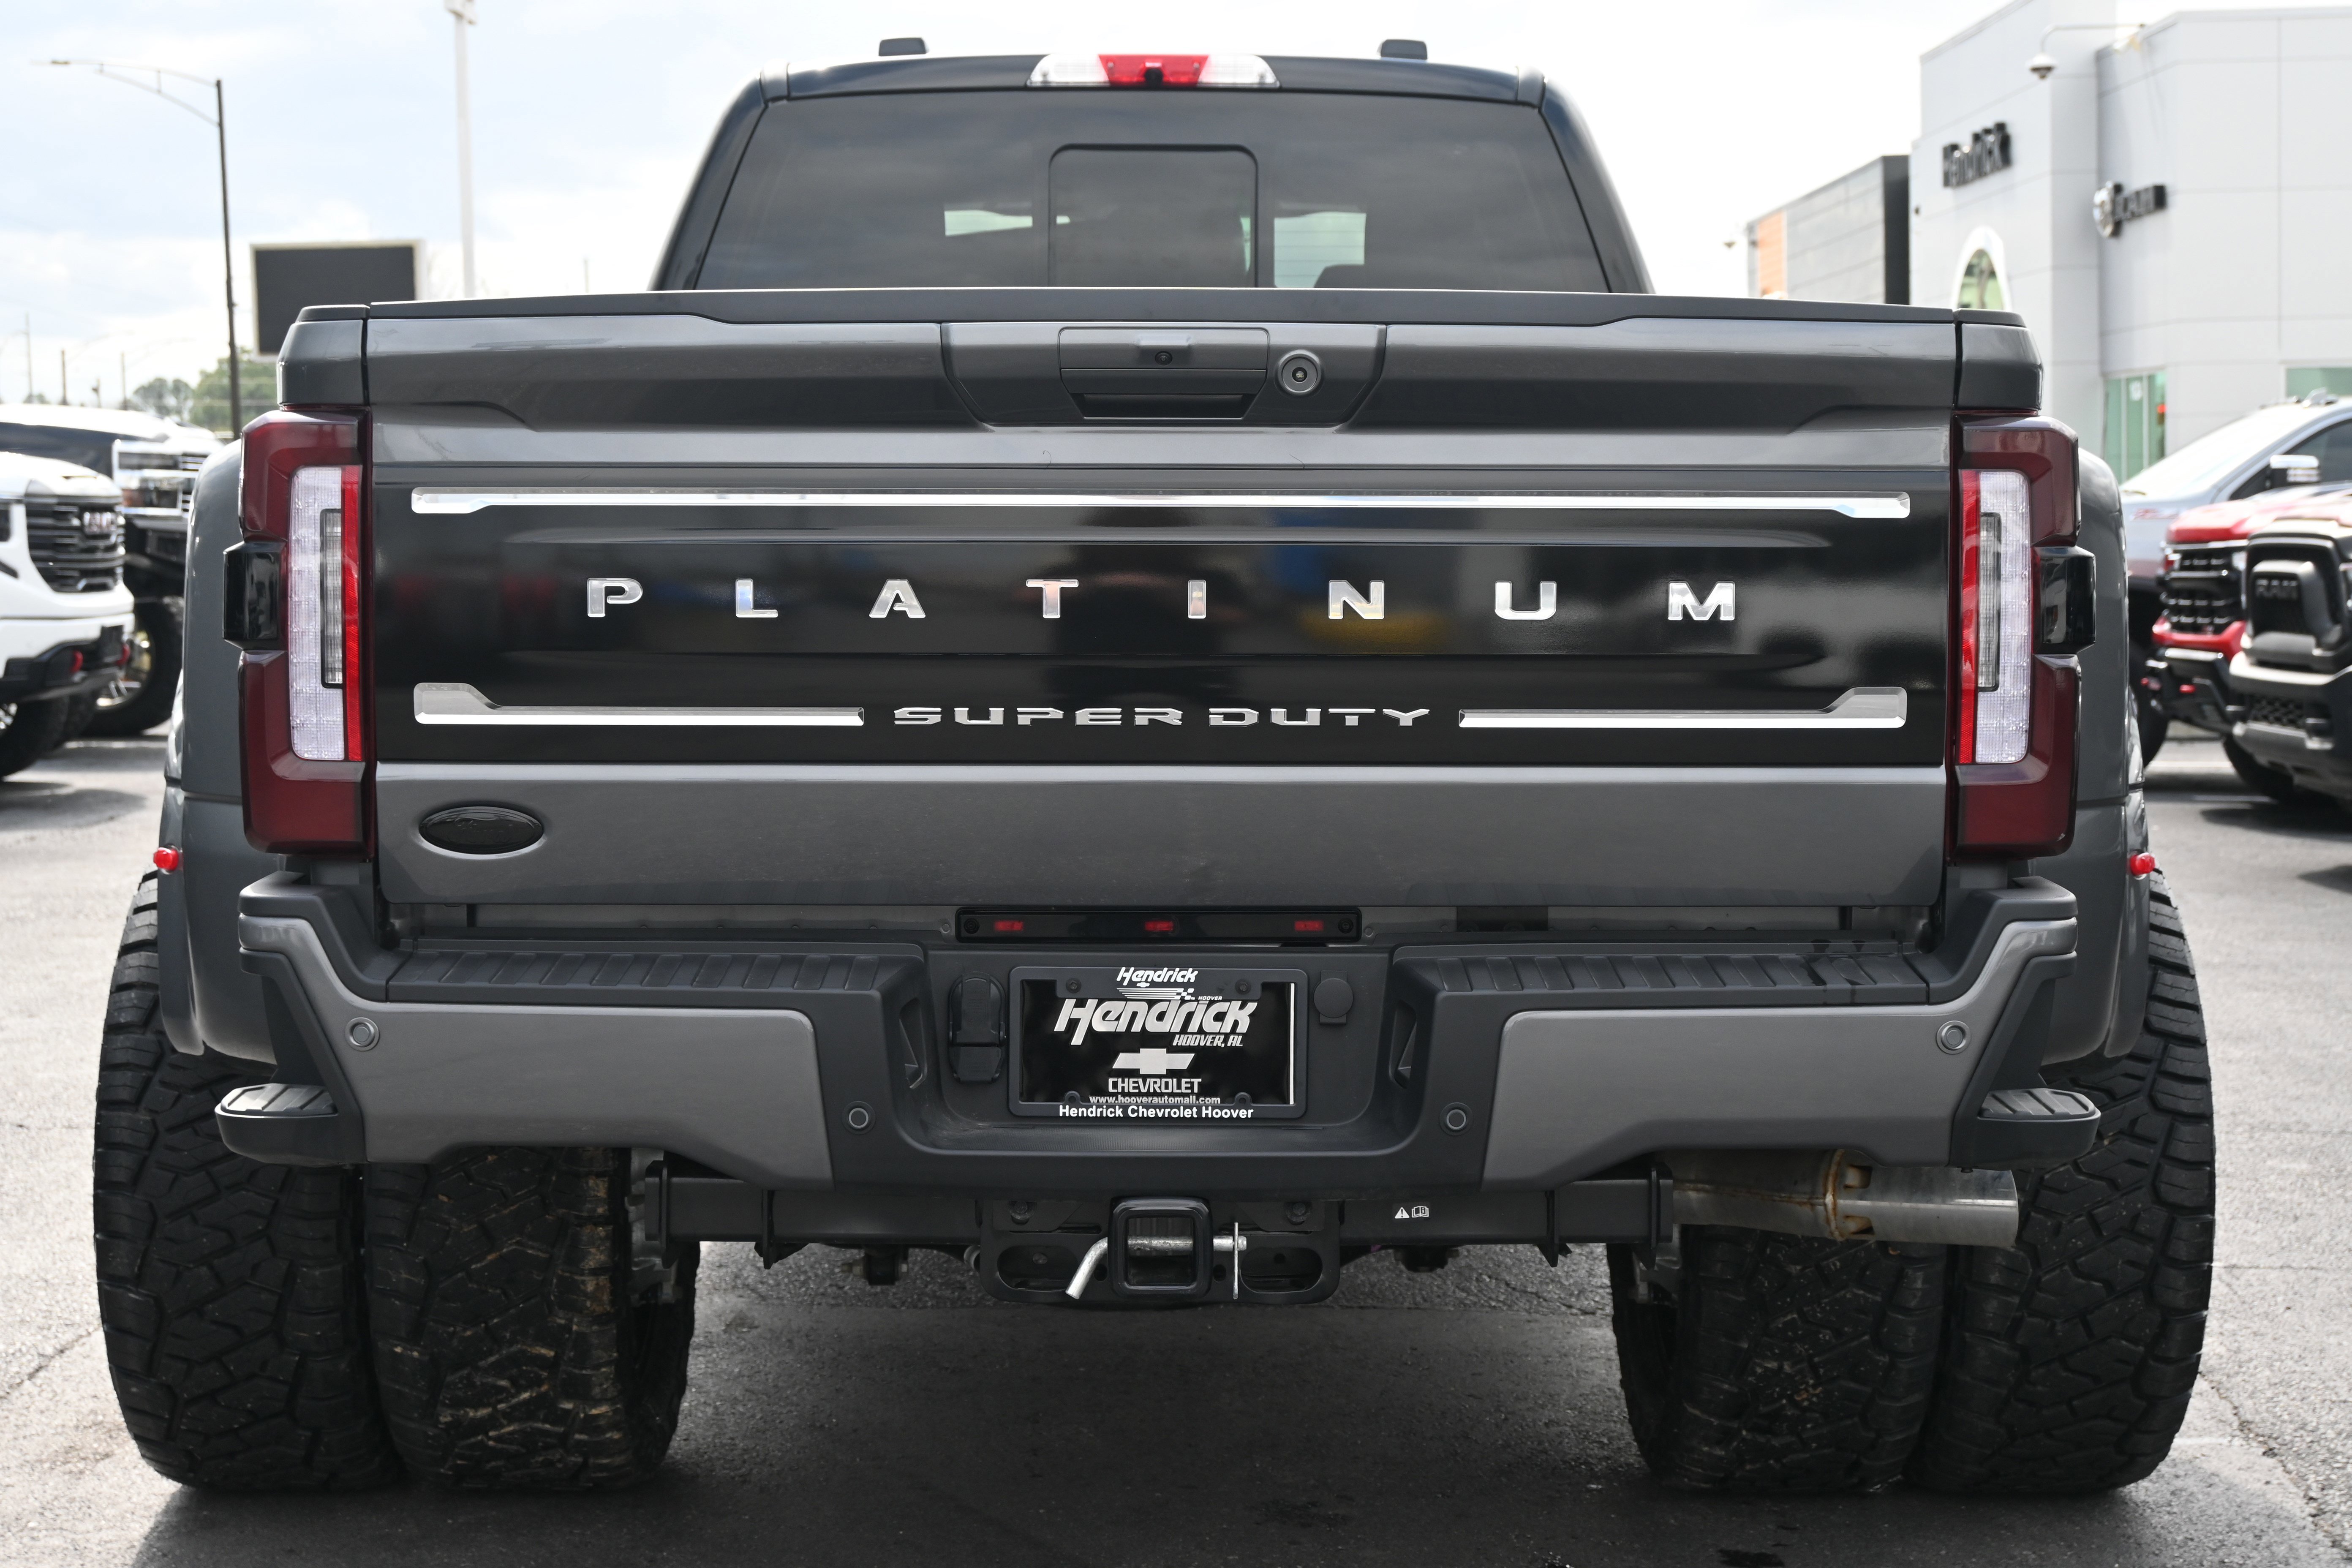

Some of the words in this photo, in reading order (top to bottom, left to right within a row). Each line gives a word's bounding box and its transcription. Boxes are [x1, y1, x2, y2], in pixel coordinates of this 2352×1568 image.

[587, 577, 1736, 621] PLATINUM
[893, 707, 1183, 726] SUPER
[1209, 708, 1430, 727] DUTY
[1116, 967, 1198, 986] Hendrick
[1054, 999, 1258, 1045] Hendrick
[1172, 1034, 1225, 1048] HOOVER,
[1227, 1035, 1243, 1047] AL
[1108, 1078, 1202, 1093] CHEVROLET
[1089, 1094, 1221, 1104] www.hooverautomall.com
[1059, 1105, 1123, 1117] Hendrick
[1127, 1105, 1198, 1118] Chevrolet
[1202, 1106, 1254, 1118] Hoover
